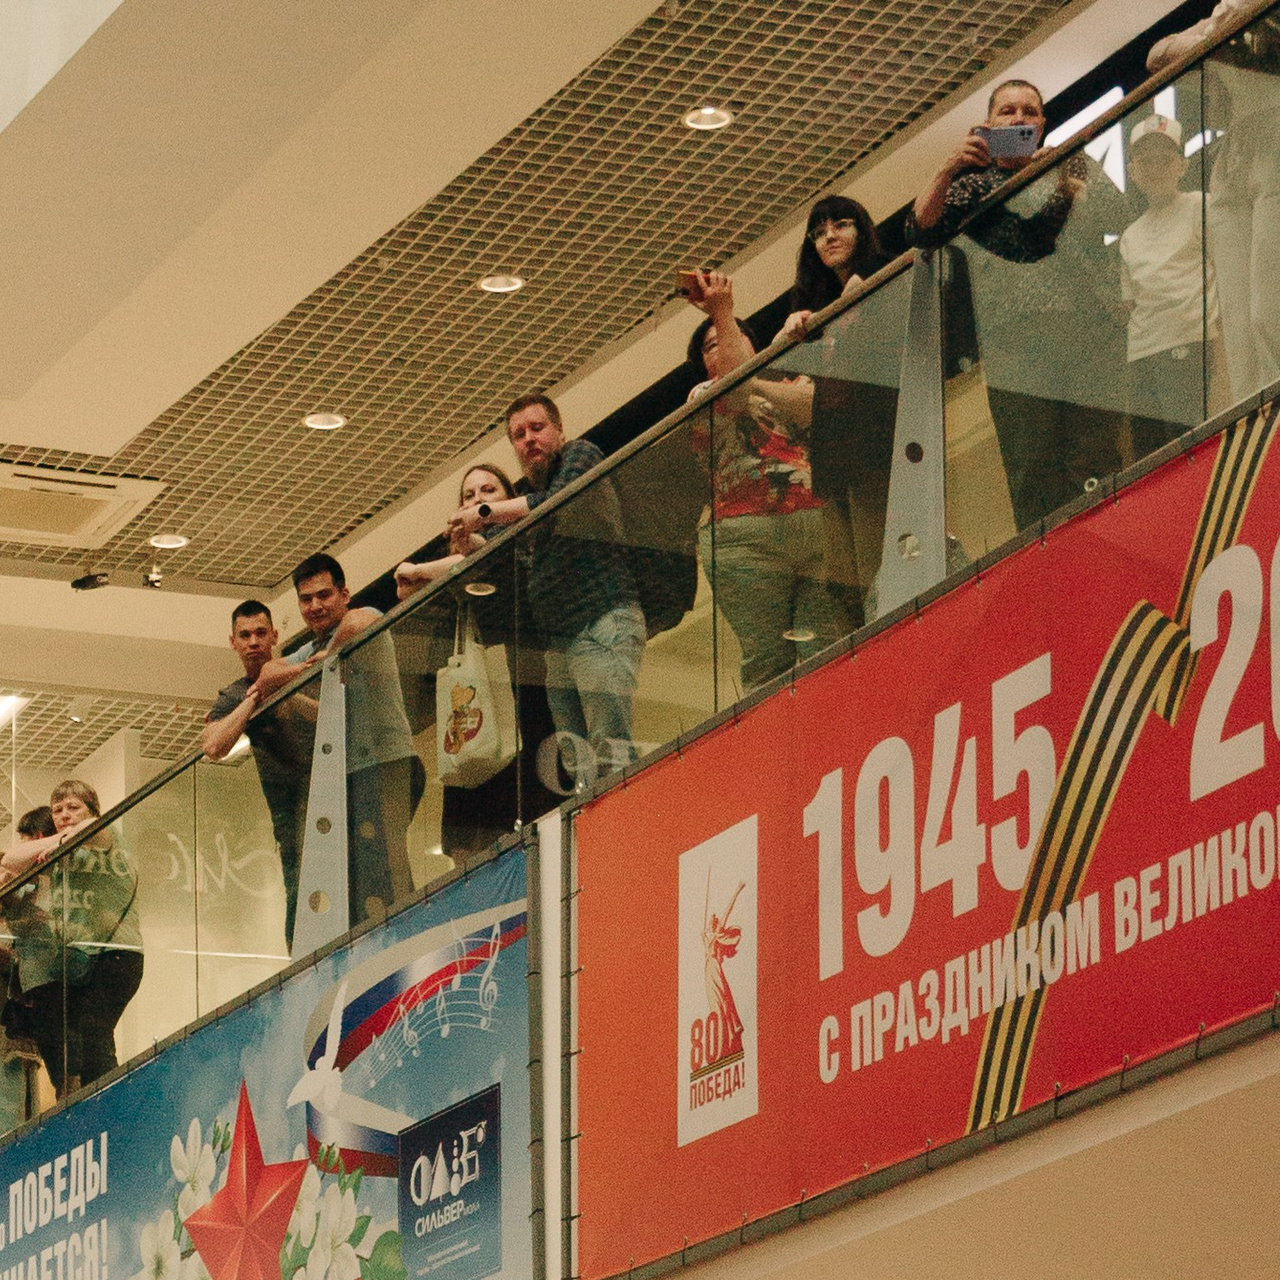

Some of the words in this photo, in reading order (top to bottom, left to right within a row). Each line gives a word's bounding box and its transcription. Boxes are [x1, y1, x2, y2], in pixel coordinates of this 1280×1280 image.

[803, 652, 1057, 982] 1945
[1190, 544, 1280, 802] 2
[819, 1015, 841, 1084] С
[851, 891, 1101, 1071] ПРАЗДНИКОМ
[1114, 803, 1280, 954] ВЕЛИКО
[690, 1011, 719, 1073] 80
[690, 1062, 746, 1112] ПОБЕДА!
[9, 1131, 109, 1245] ПОБЕДЫ
[415, 1199, 464, 1238] СИЛЬВЕР
